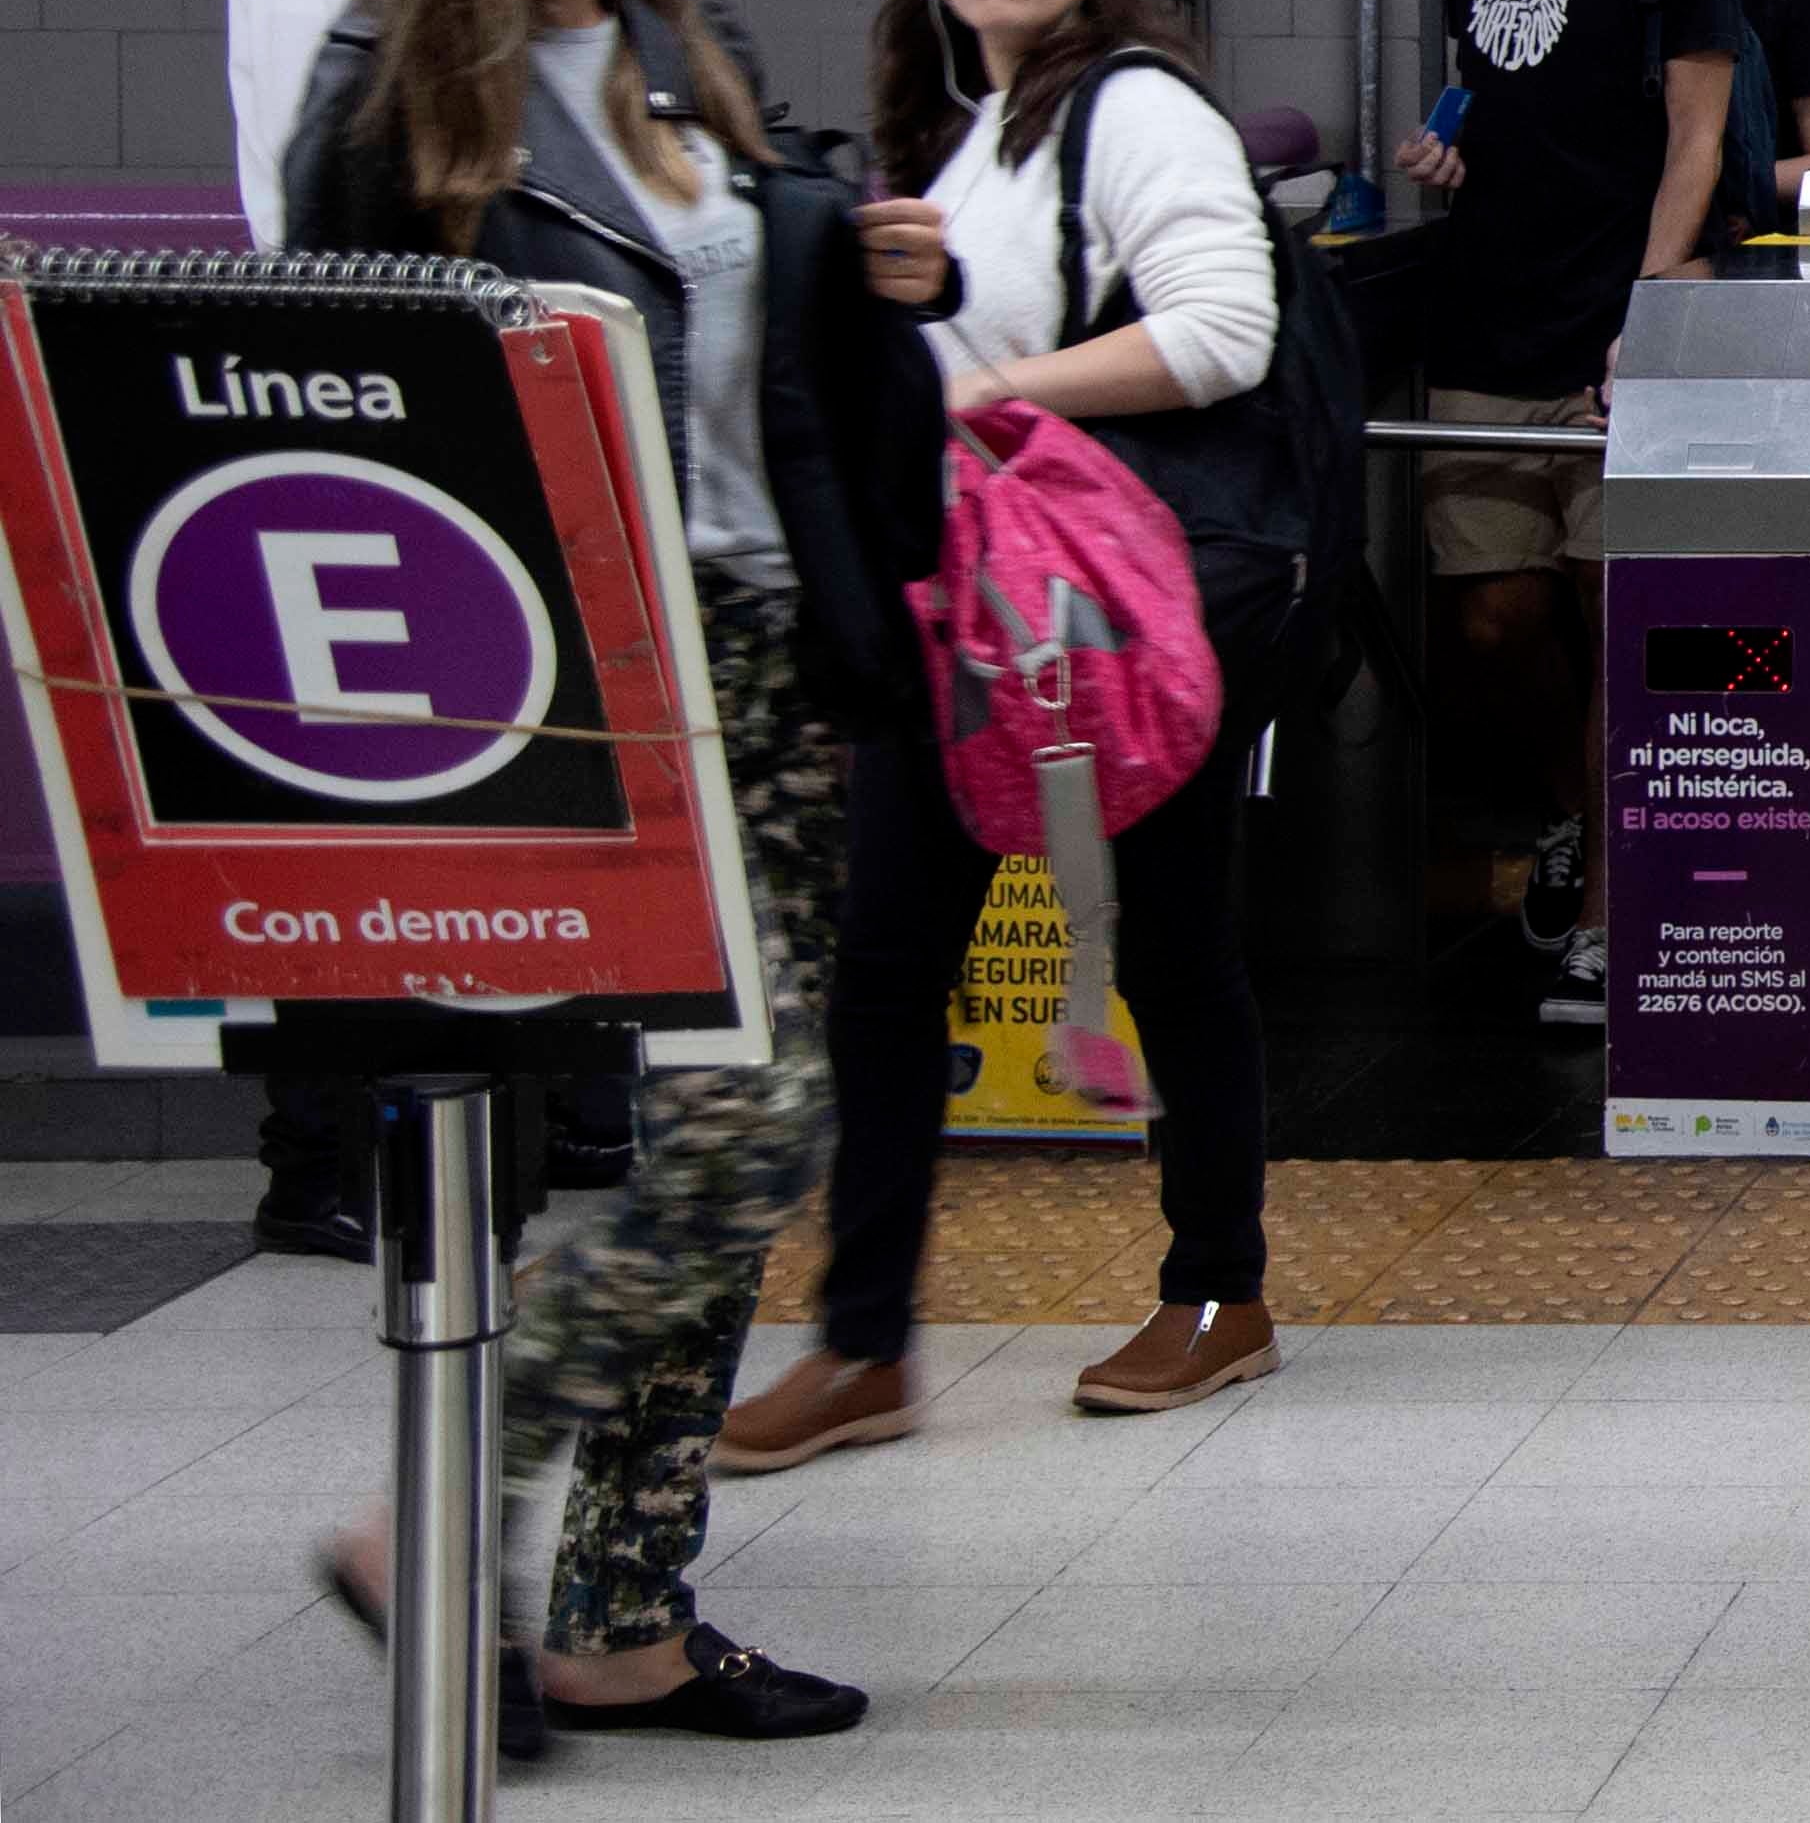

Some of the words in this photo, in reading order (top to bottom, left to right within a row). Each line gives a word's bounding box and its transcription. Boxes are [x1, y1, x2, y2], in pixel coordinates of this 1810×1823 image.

[174, 355, 408, 420] Línea
[257, 530, 435, 725] E
[1669, 712, 1697, 736] Ni
[1703, 712, 1765, 740] loca,
[1630, 742, 1653, 767] ni
[1658, 742, 1810, 771] perseguida,
[1647, 774, 1671, 798] ni
[1677, 773, 1794, 798] histérica.
[1622, 807, 1646, 830] El
[1653, 811, 1731, 831] acoso
[223, 900, 341, 944] Con
[359, 898, 591, 942] demora
[1660, 922, 1705, 941] Para
[1709, 923, 1784, 944] reporte
[1658, 950, 1671, 967] y
[1674, 944, 1786, 965] contención
[1638, 969, 1707, 989] mandá
[1711, 973, 1737, 989] un
[1741, 970, 1785, 989] SMS
[1788, 970, 1806, 988] al
[965, 996, 1003, 1024] EN
[1638, 994, 1702, 1013] 22676
[1706, 993, 1806, 1014] (ACOSO).
